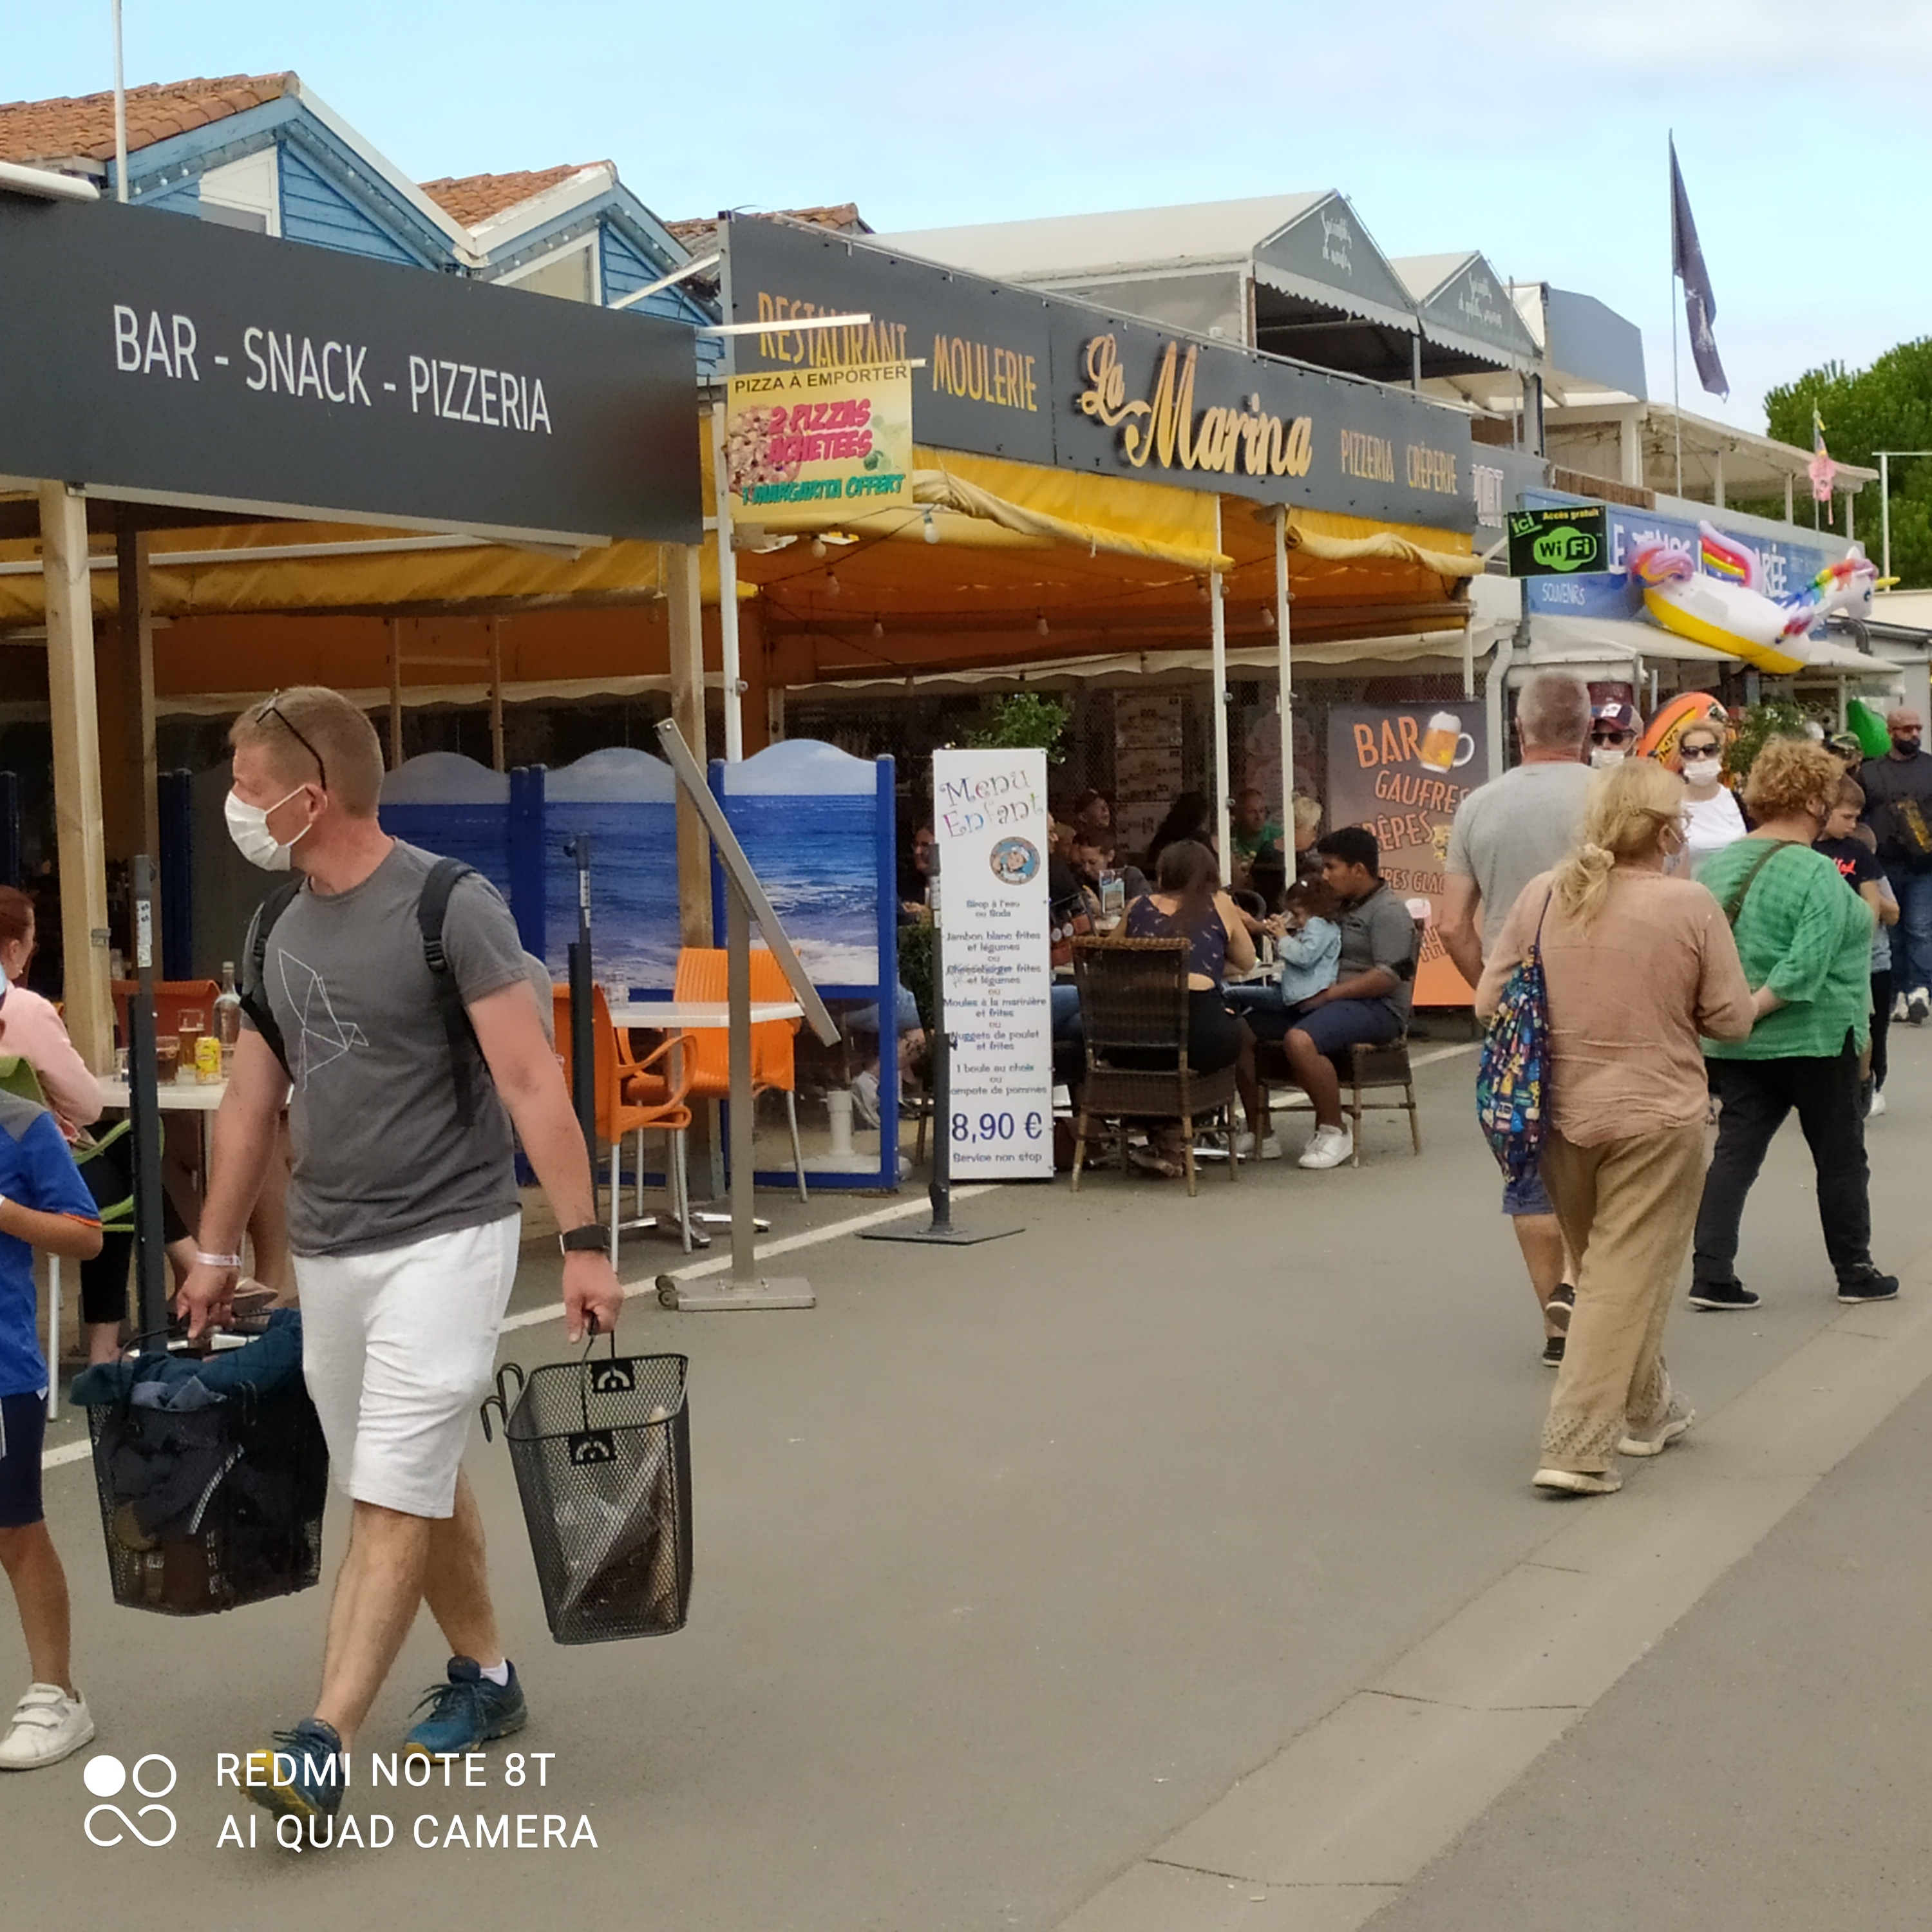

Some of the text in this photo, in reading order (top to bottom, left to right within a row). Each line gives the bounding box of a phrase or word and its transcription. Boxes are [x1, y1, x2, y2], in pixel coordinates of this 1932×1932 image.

[758, 292, 1037, 411] RESTAURANT MOULERIE
[113, 305, 199, 382] BAR
[243, 327, 372, 406] SNACK
[409, 355, 553, 434] PIZZERIA
[735, 377, 784, 393] PIZZA
[808, 365, 907, 387] EMPORTER
[1076, 333, 1312, 478] La Marina
[768, 399, 871, 435] 2 PIZZAS
[767, 430, 873, 464] ACHETEES
[1340, 430, 1458, 495] PIZZERIA CRÊPERIE
[752, 479, 842, 506] MARGARITA
[846, 475, 905, 498] OFFERT
[1511, 512, 1534, 533] ici
[1543, 508, 1600, 521] Accès gratuit
[1354, 716, 1423, 768] BAR
[940, 770, 1030, 807] Menu
[942, 792, 1043, 838] Enfant
[947, 930, 1041, 941] Jambon blanc frites
[980, 943, 1020, 954] légumes
[1017, 963, 1041, 972] frites
[981, 975, 1021, 987] légumes
[943, 998, 978, 1007] Moules
[989, 1009, 1014, 1017] frites
[951, 1030, 1039, 1043] Nuggets de poulet
[990, 1041, 1014, 1050] frites
[965, 1064, 990, 1073] boule
[1009, 1063, 1034, 1072] choix
[951, 1088, 988, 1097] ompote
[1006, 1086, 1047, 1096] pommes
[952, 1112, 1042, 1143] 8,90 €
[953, 1153, 992, 1163] Service
[1019, 1152, 1042, 1163] stop
